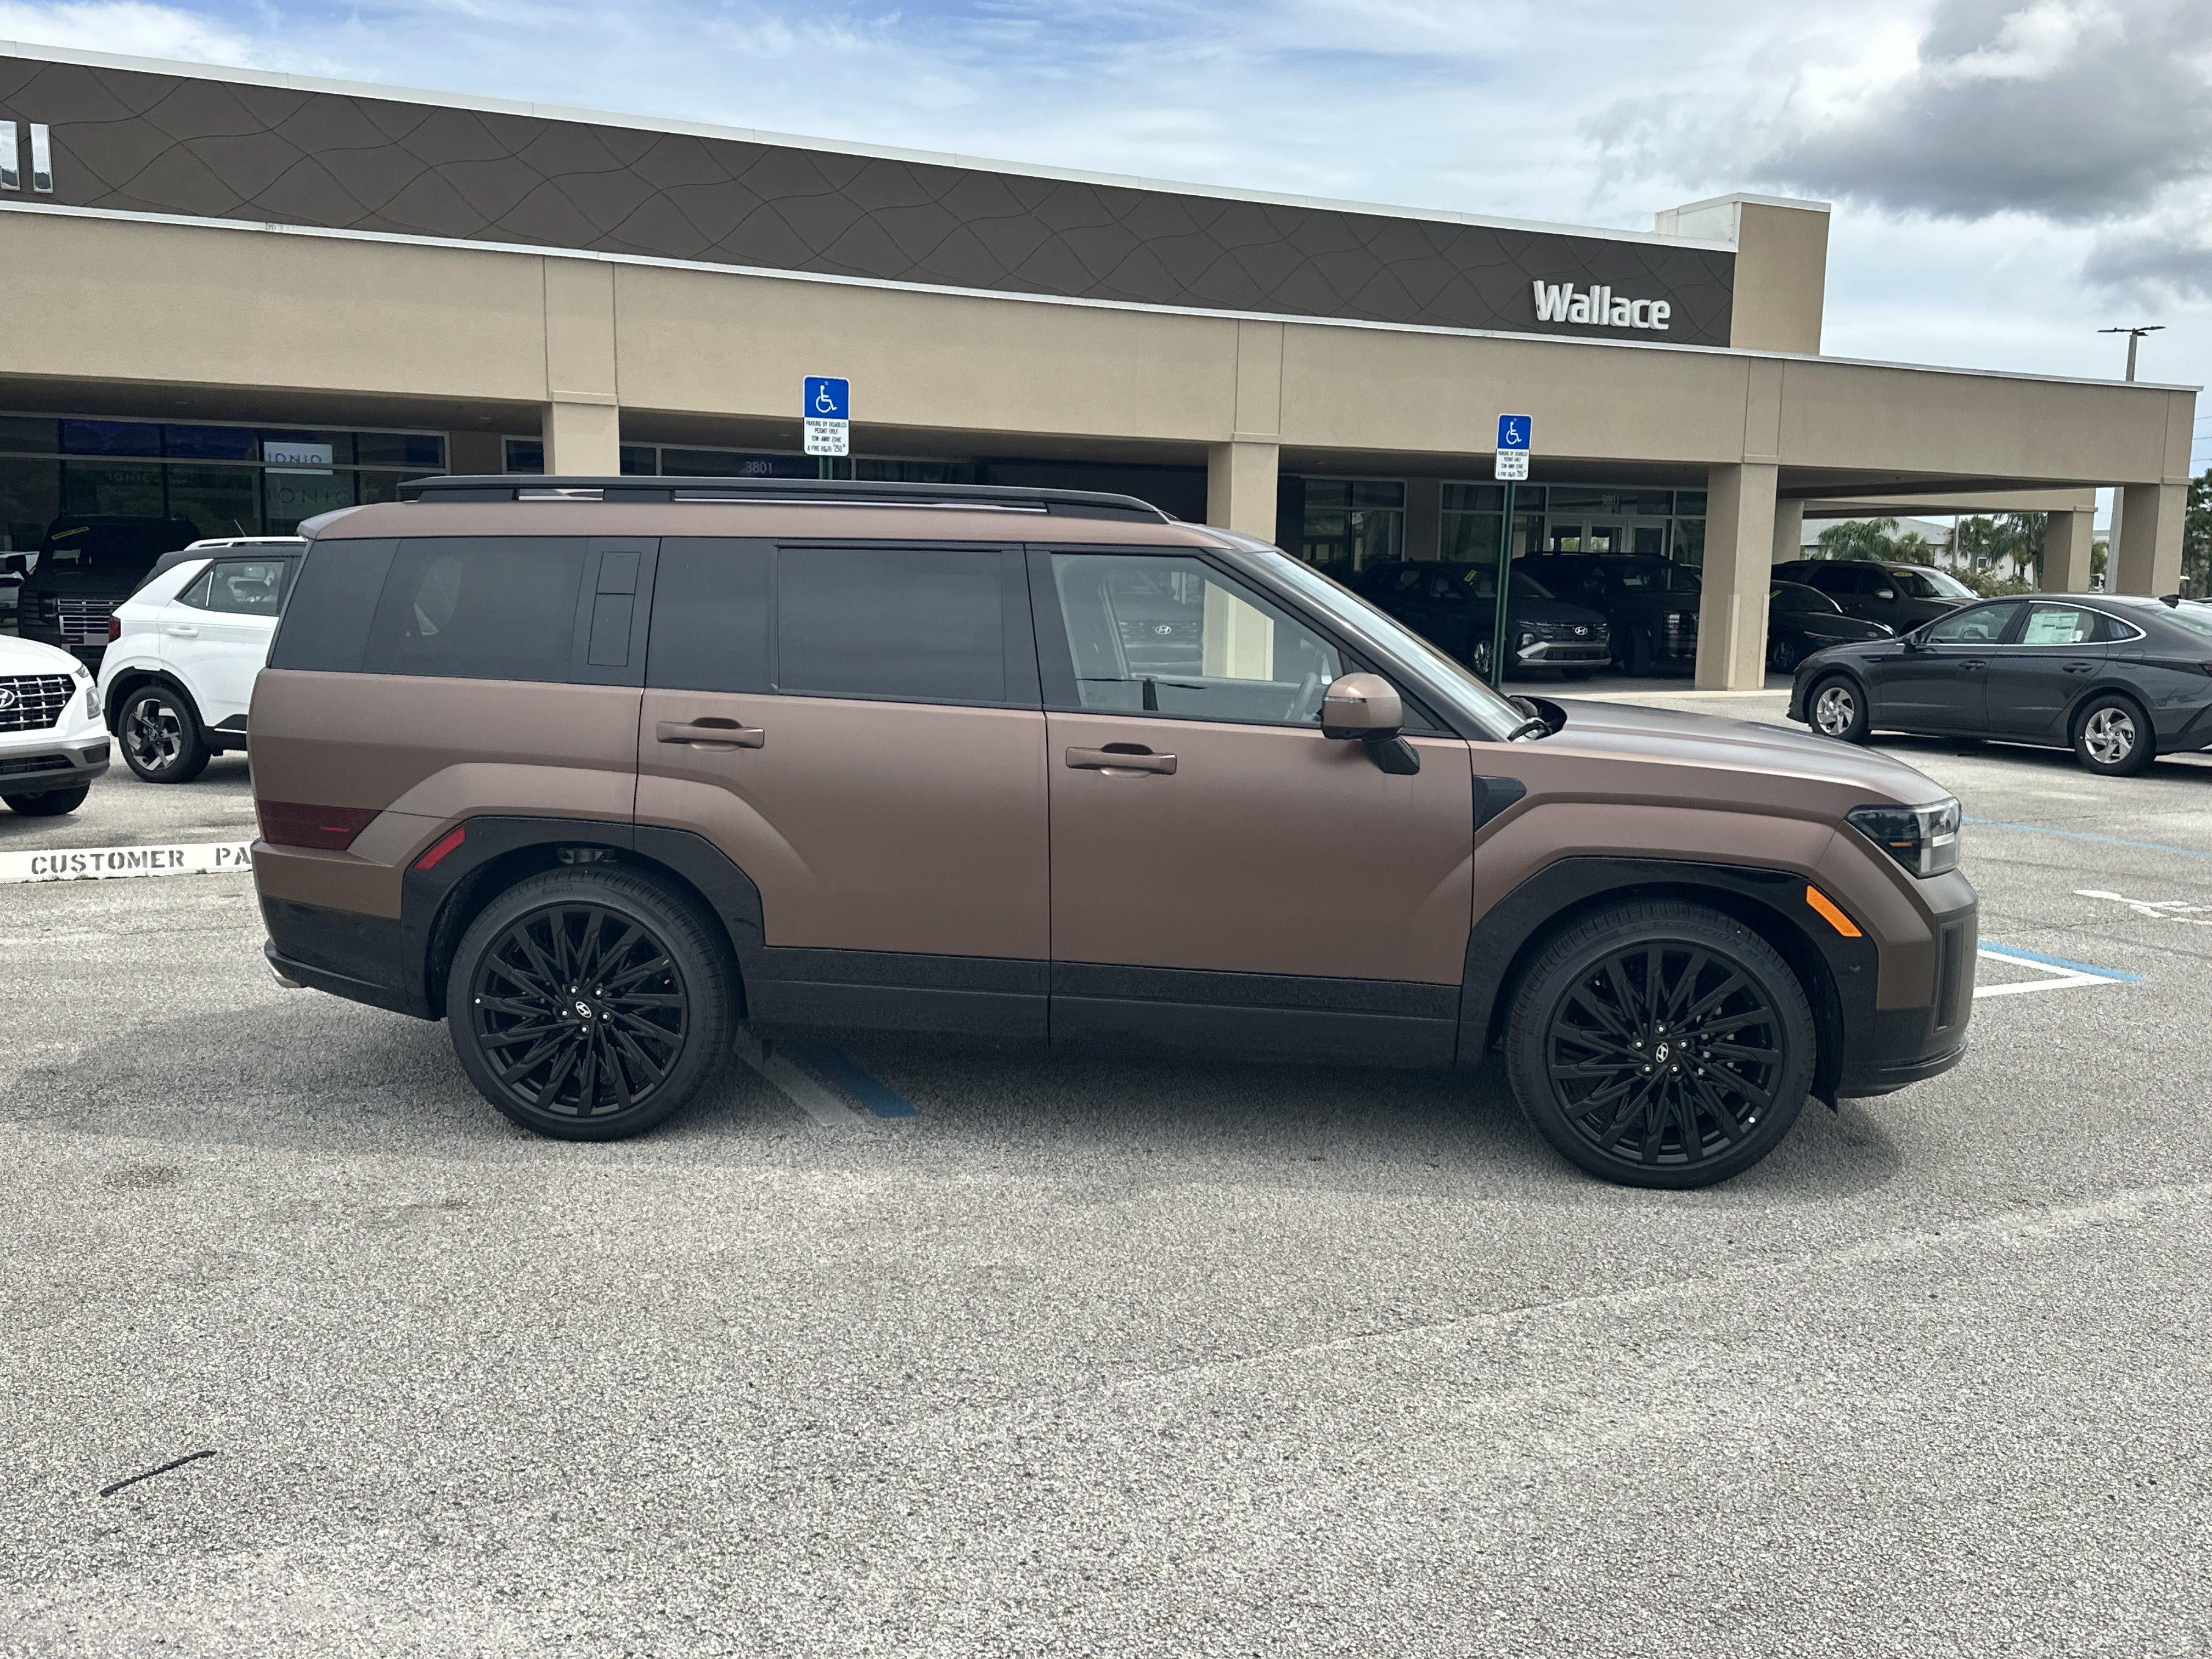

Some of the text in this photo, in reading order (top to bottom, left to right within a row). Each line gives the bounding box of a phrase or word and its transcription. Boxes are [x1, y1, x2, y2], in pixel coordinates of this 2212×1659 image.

[1533, 280, 1671, 329] Wallace
[745, 461, 773, 474] 3801
[31, 850, 184, 874] CUSTOMER
